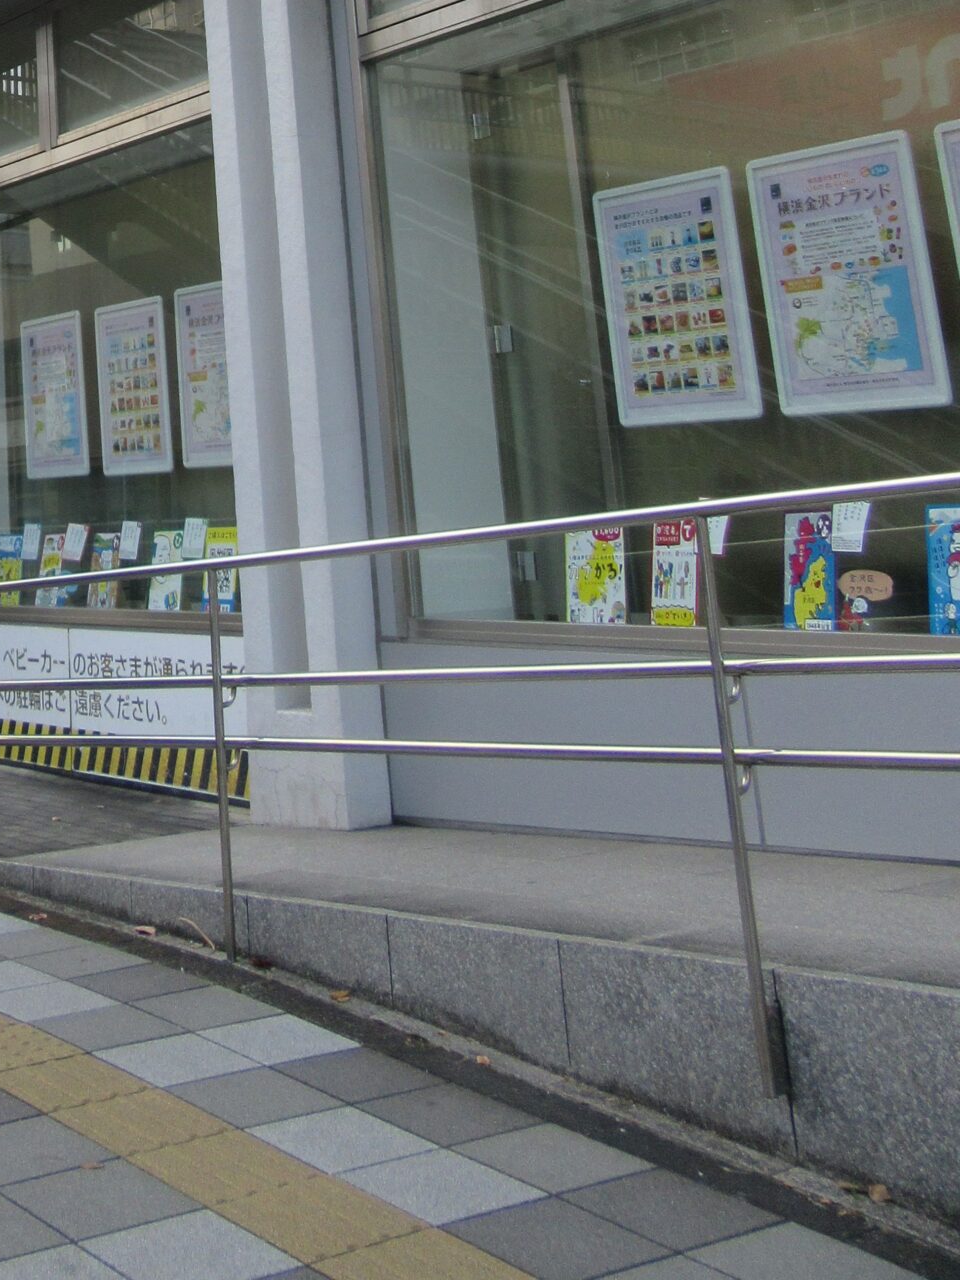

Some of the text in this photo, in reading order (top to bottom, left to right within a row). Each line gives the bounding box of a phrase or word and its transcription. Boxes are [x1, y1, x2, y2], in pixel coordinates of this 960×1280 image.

[778, 183, 891, 217] 横浜金沢ブランド
